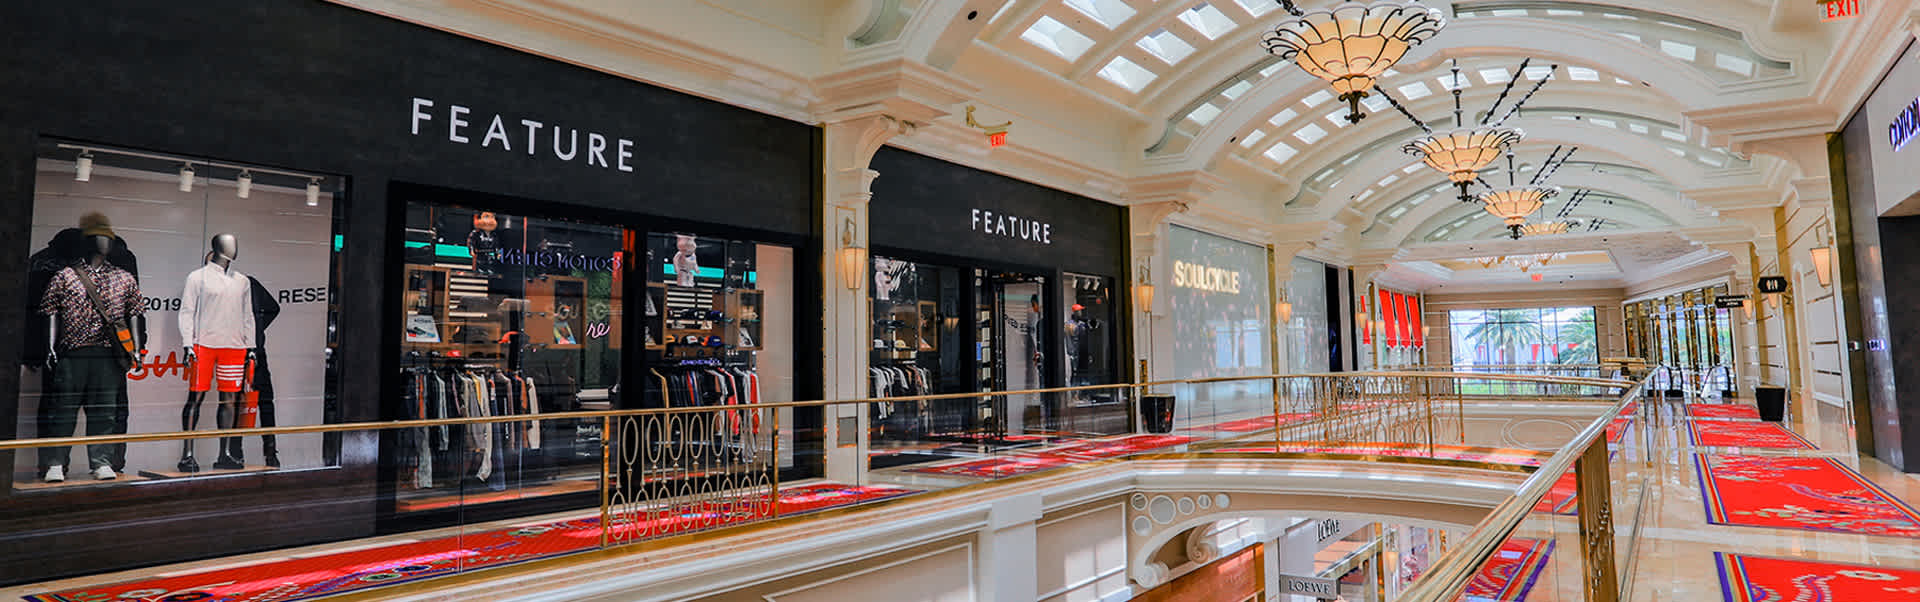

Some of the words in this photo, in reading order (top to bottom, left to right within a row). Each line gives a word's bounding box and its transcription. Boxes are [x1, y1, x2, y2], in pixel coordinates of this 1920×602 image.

[1827, 0, 1859, 18] EXIT
[411, 97, 634, 173] FEATURE
[971, 208, 1051, 244] FEATURE
[1174, 259, 1240, 294] SOULCYCLE
[143, 296, 182, 311] 2019
[278, 287, 327, 304] RESE
[1317, 518, 1341, 542] LOEWE
[1288, 580, 1330, 594] LOEWE
